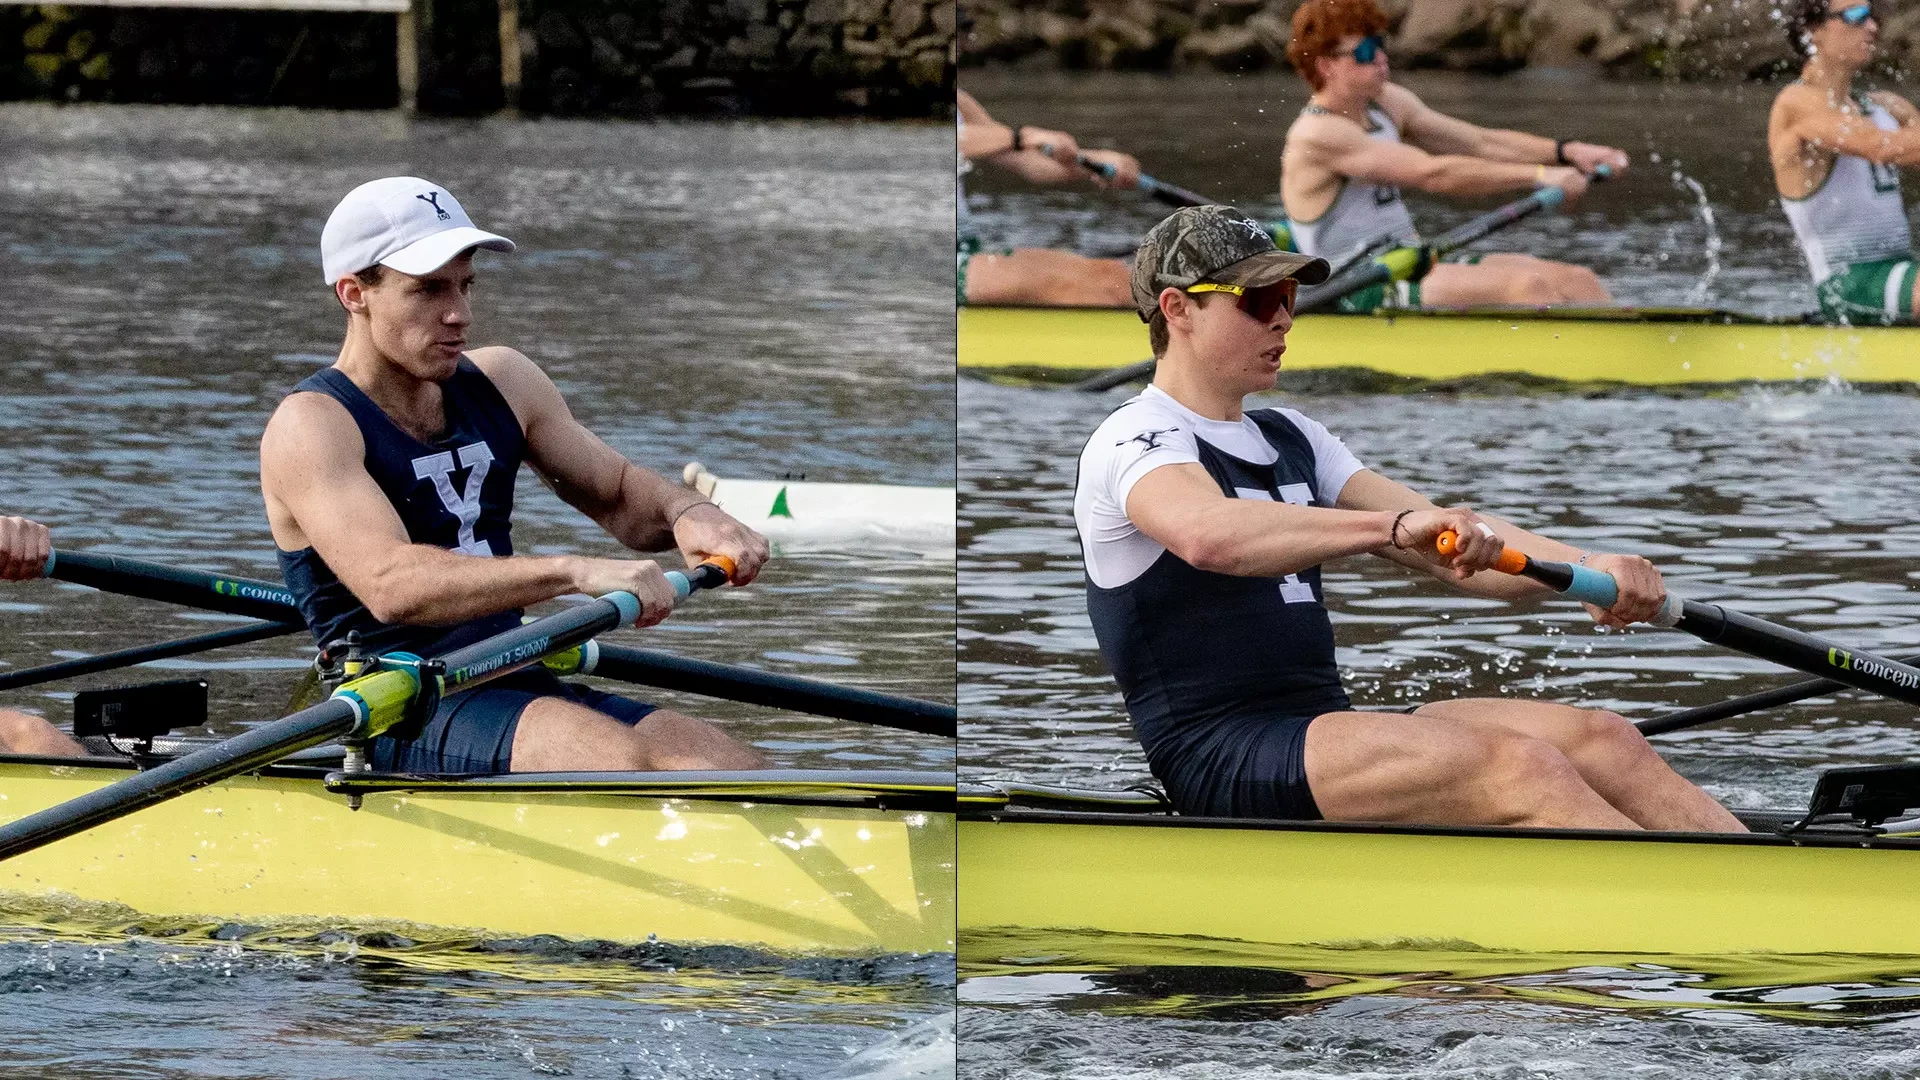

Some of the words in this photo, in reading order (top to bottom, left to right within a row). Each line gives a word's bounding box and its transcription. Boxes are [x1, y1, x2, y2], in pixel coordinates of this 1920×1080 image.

[416, 191, 446, 214] Y
[1133, 431, 1164, 452] Y
[411, 441, 495, 557] Y
[469, 655, 503, 677] concept
[504, 652, 511, 664] 2
[1853, 657, 1919, 689] concept
